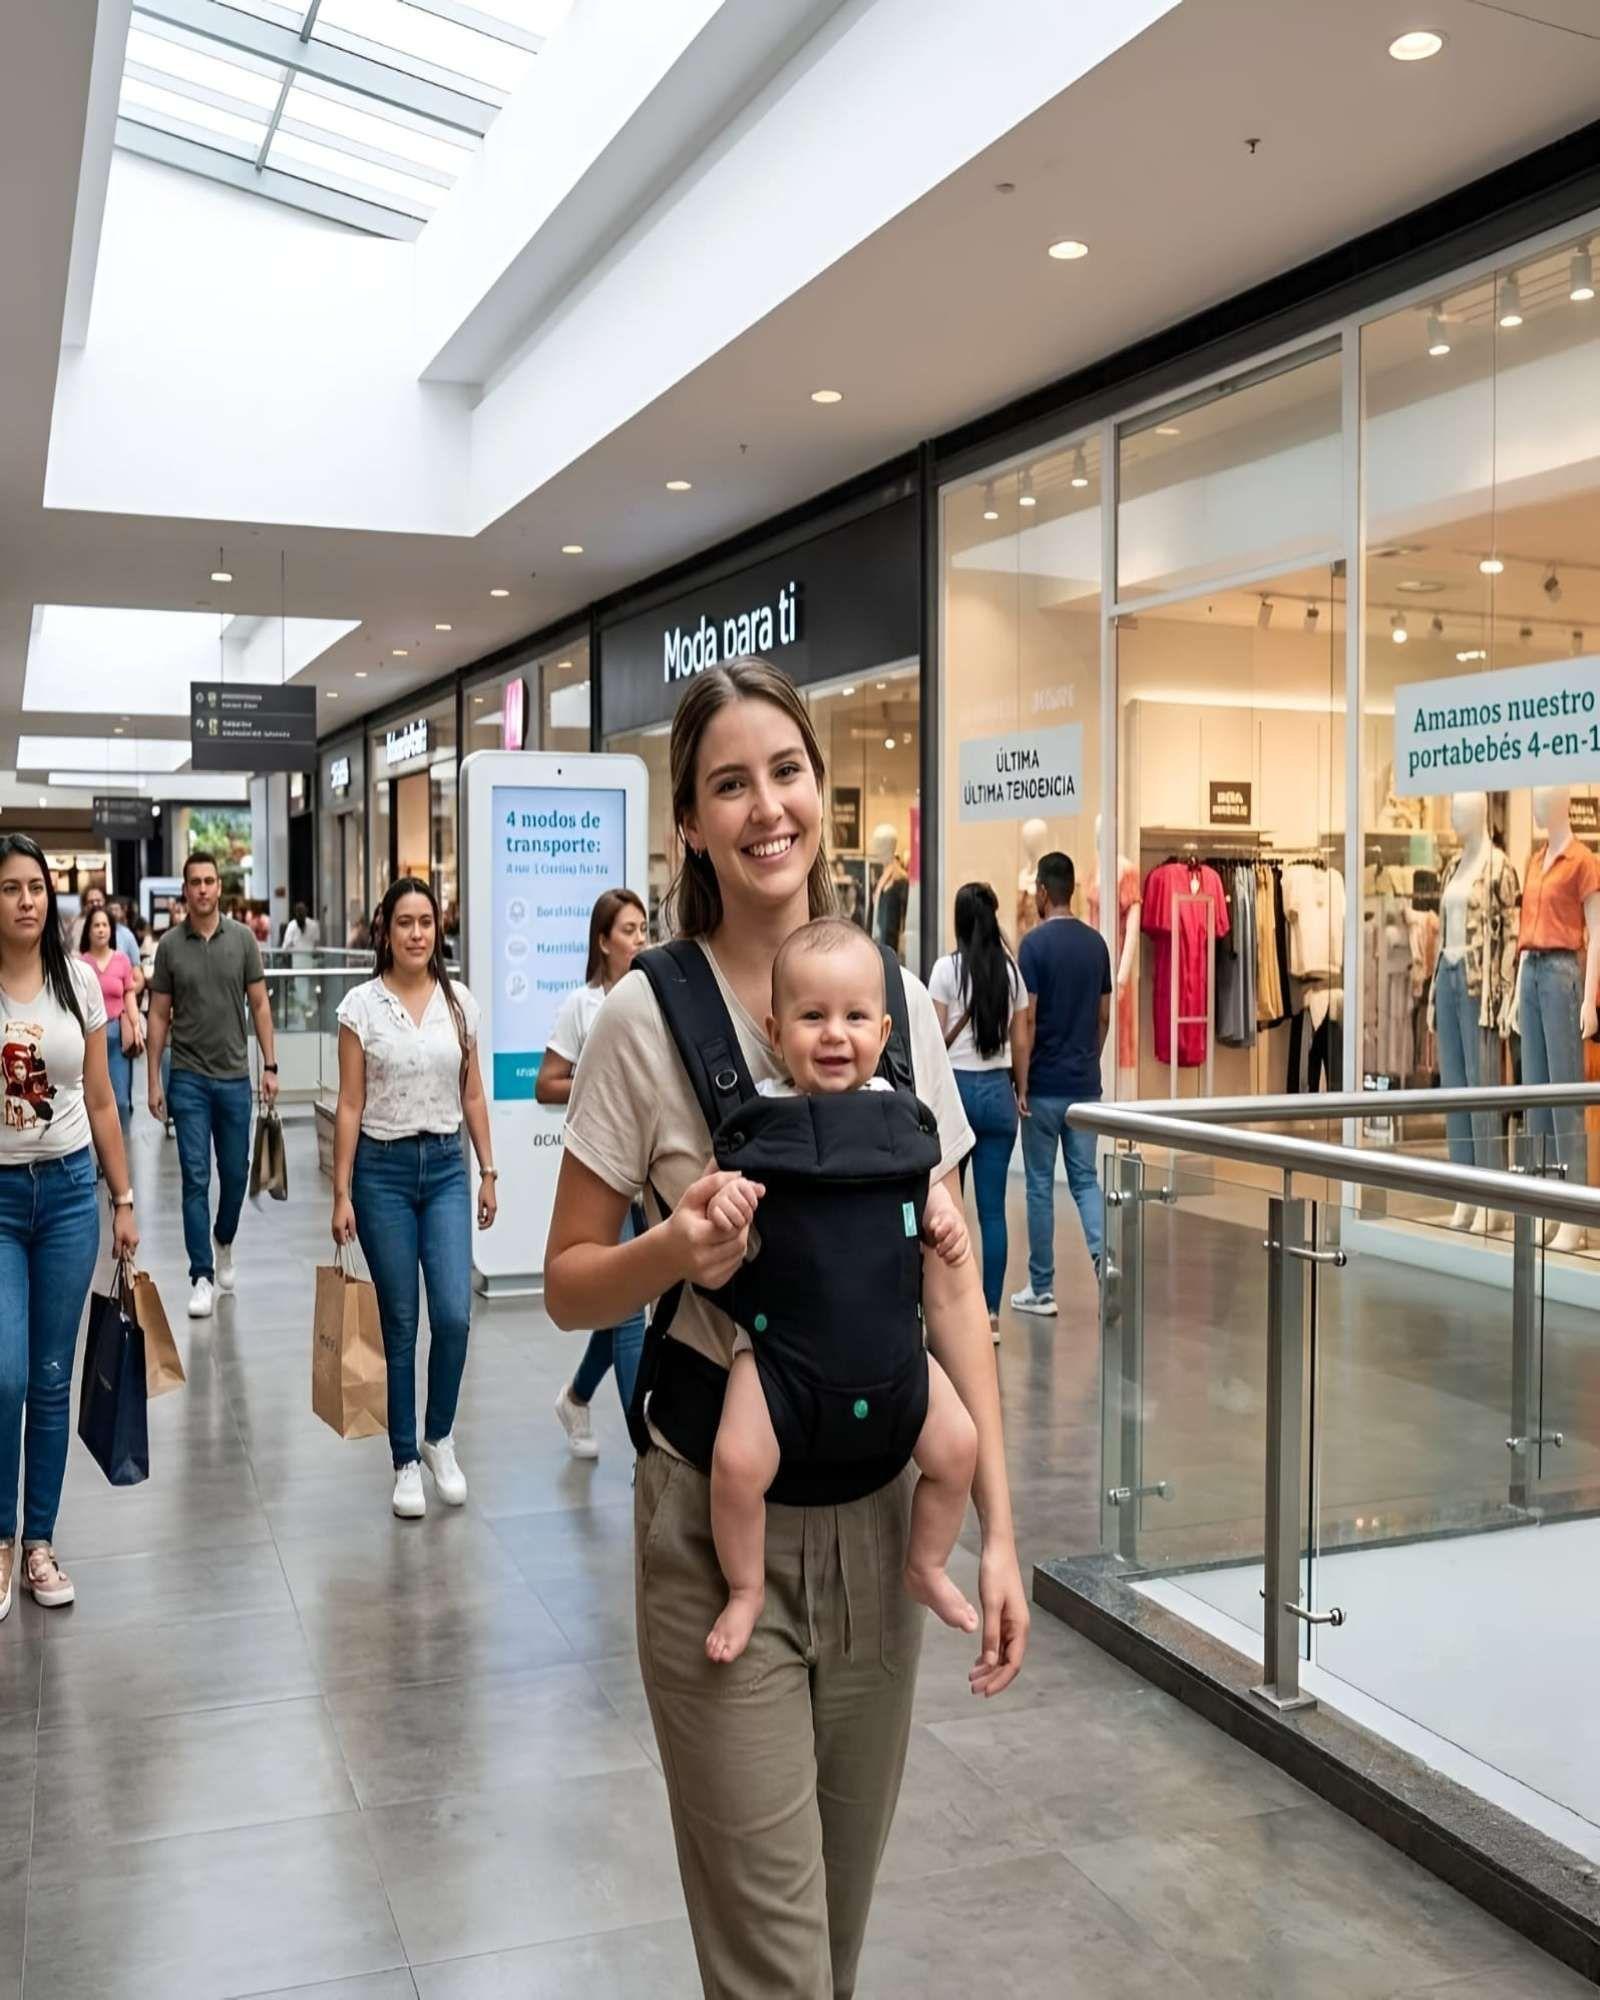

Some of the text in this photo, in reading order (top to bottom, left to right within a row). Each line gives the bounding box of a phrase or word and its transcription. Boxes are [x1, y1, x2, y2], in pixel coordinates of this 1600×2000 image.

[664, 581, 795, 683] Moda para ti
[1414, 688, 1595, 733] Amamos nuestro
[996, 746, 1040, 773] ÚLTIMA
[1409, 724, 1600, 778] portabebés 4-en-1
[963, 780, 1004, 806] ÚLTIMA
[506, 809, 601, 829] 4 modos de
[506, 837, 601, 857] transporte:
